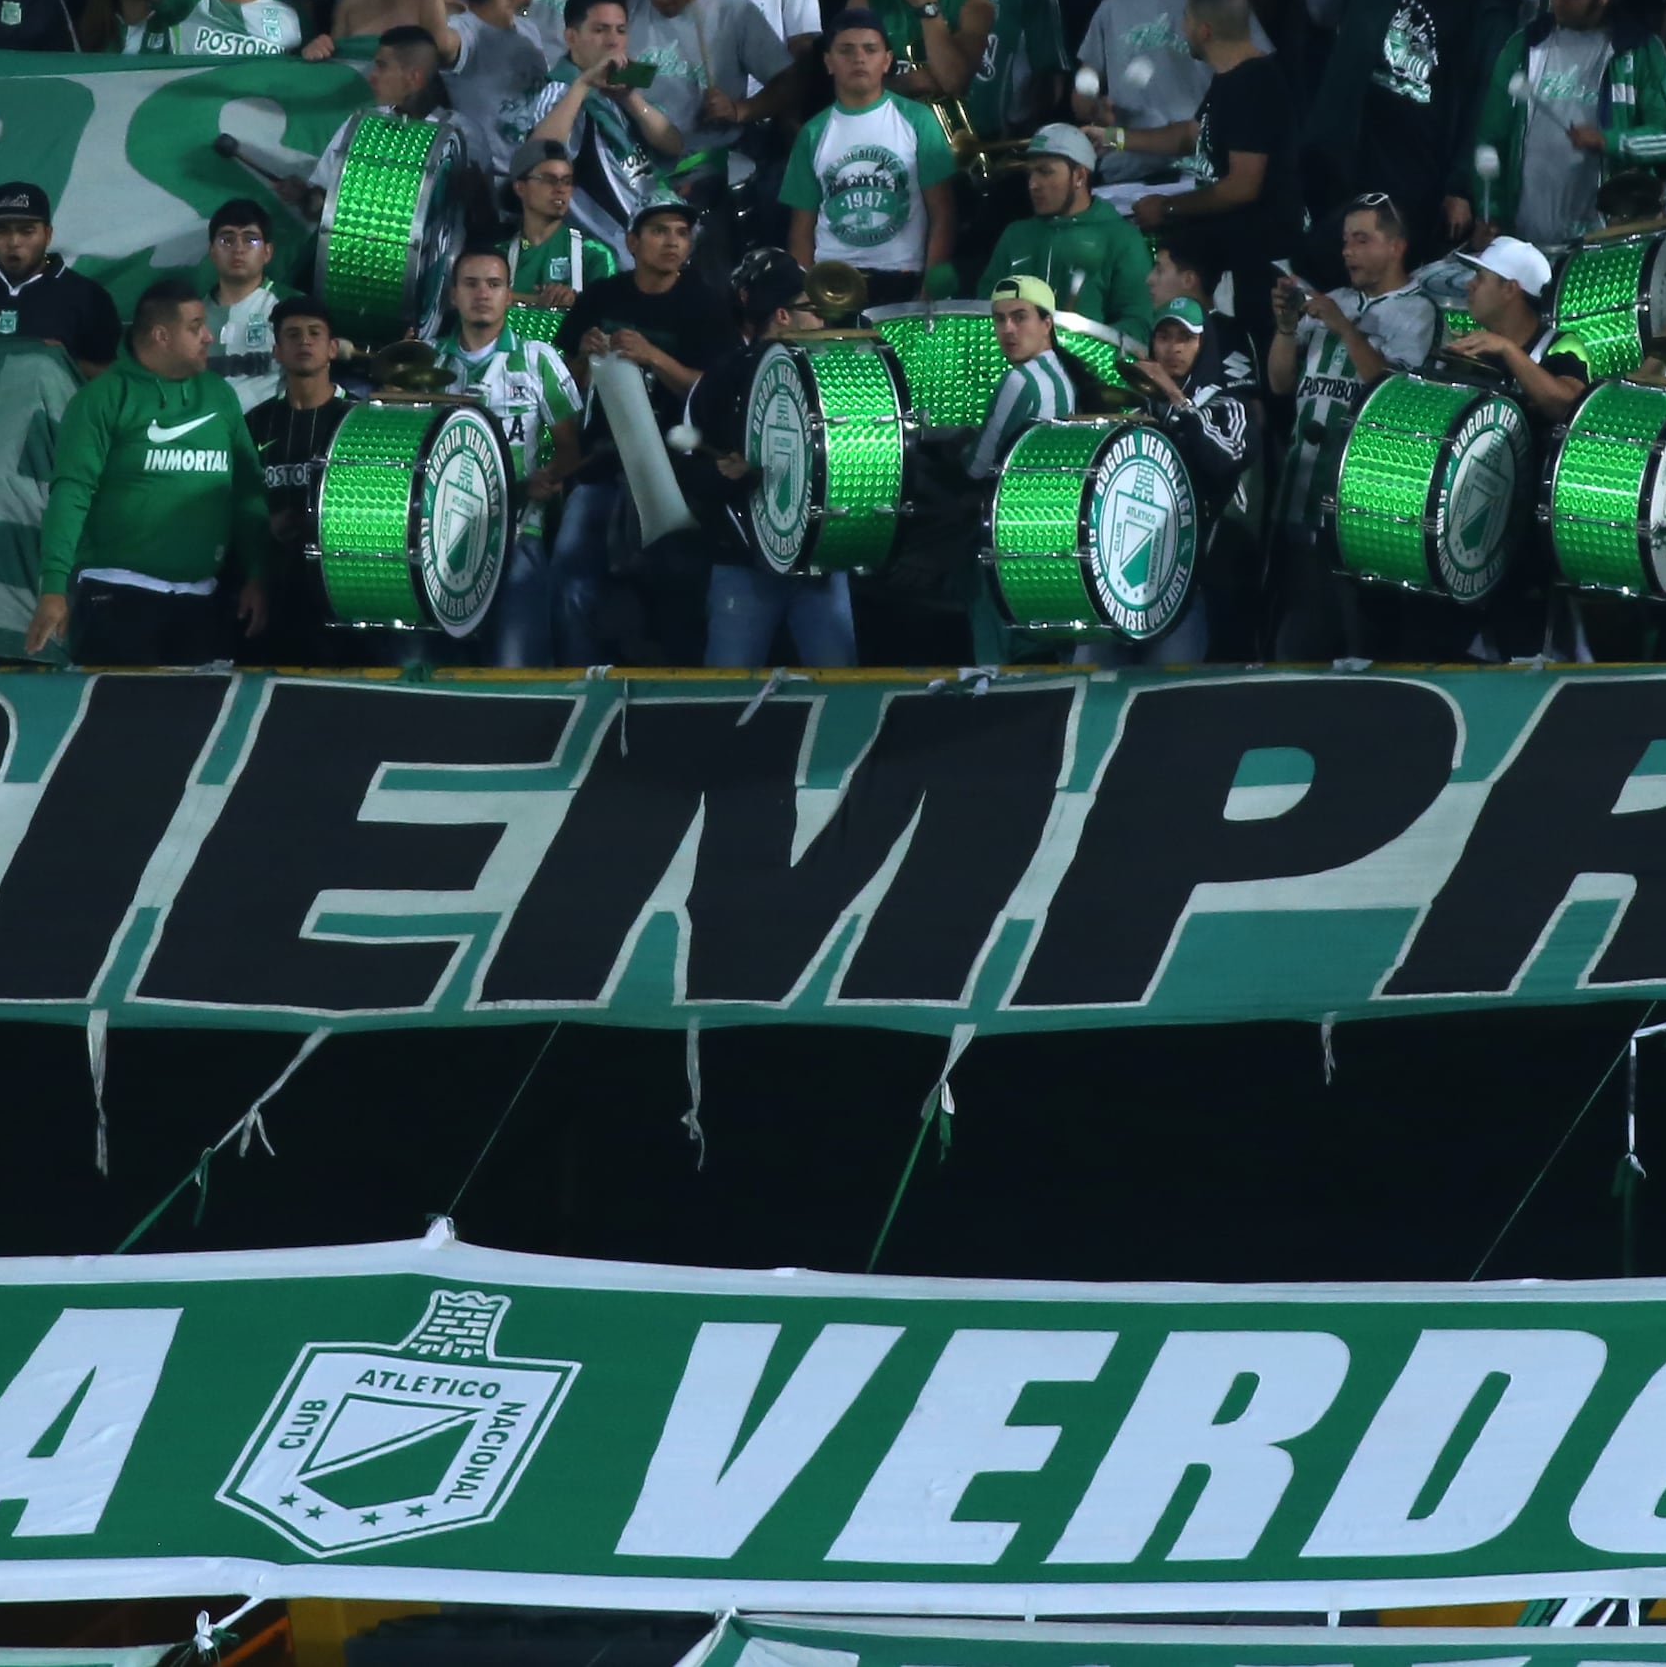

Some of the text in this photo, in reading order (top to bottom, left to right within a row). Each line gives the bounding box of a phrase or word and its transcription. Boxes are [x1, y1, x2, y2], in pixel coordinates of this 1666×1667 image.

[844, 191, 883, 210] 1947
[143, 447, 229, 473] INMORTAL
[428, 424, 501, 519] BOGOTA VERDOLAGA
[1094, 432, 1193, 528] BOGOTA VERDOLAGA
[354, 1366, 503, 1401] ATLETICO
[278, 1396, 326, 1451] CLUB
[443, 1400, 527, 1505] NACIONAL
